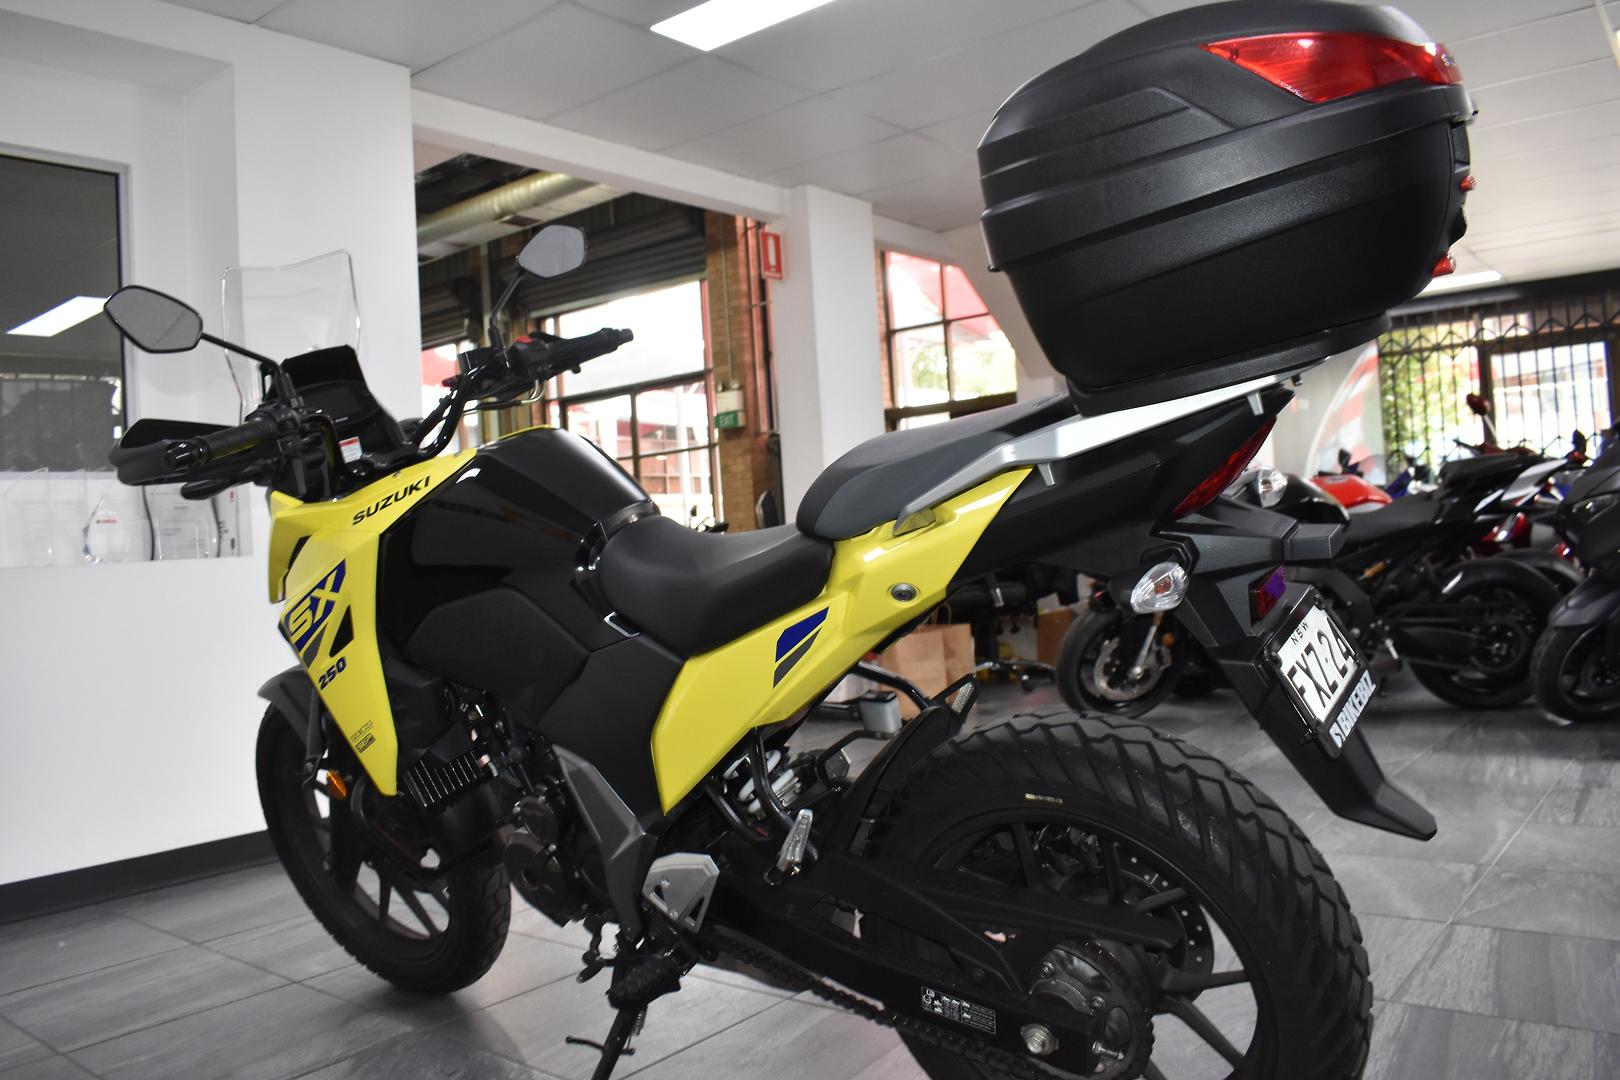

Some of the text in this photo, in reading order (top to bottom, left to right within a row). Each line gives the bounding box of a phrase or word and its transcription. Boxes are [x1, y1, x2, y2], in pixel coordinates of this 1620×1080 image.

[352, 475, 431, 526] SUZUKI
[287, 567, 340, 637] SX
[1290, 620, 1309, 646] NSW
[318, 656, 347, 690] 250
